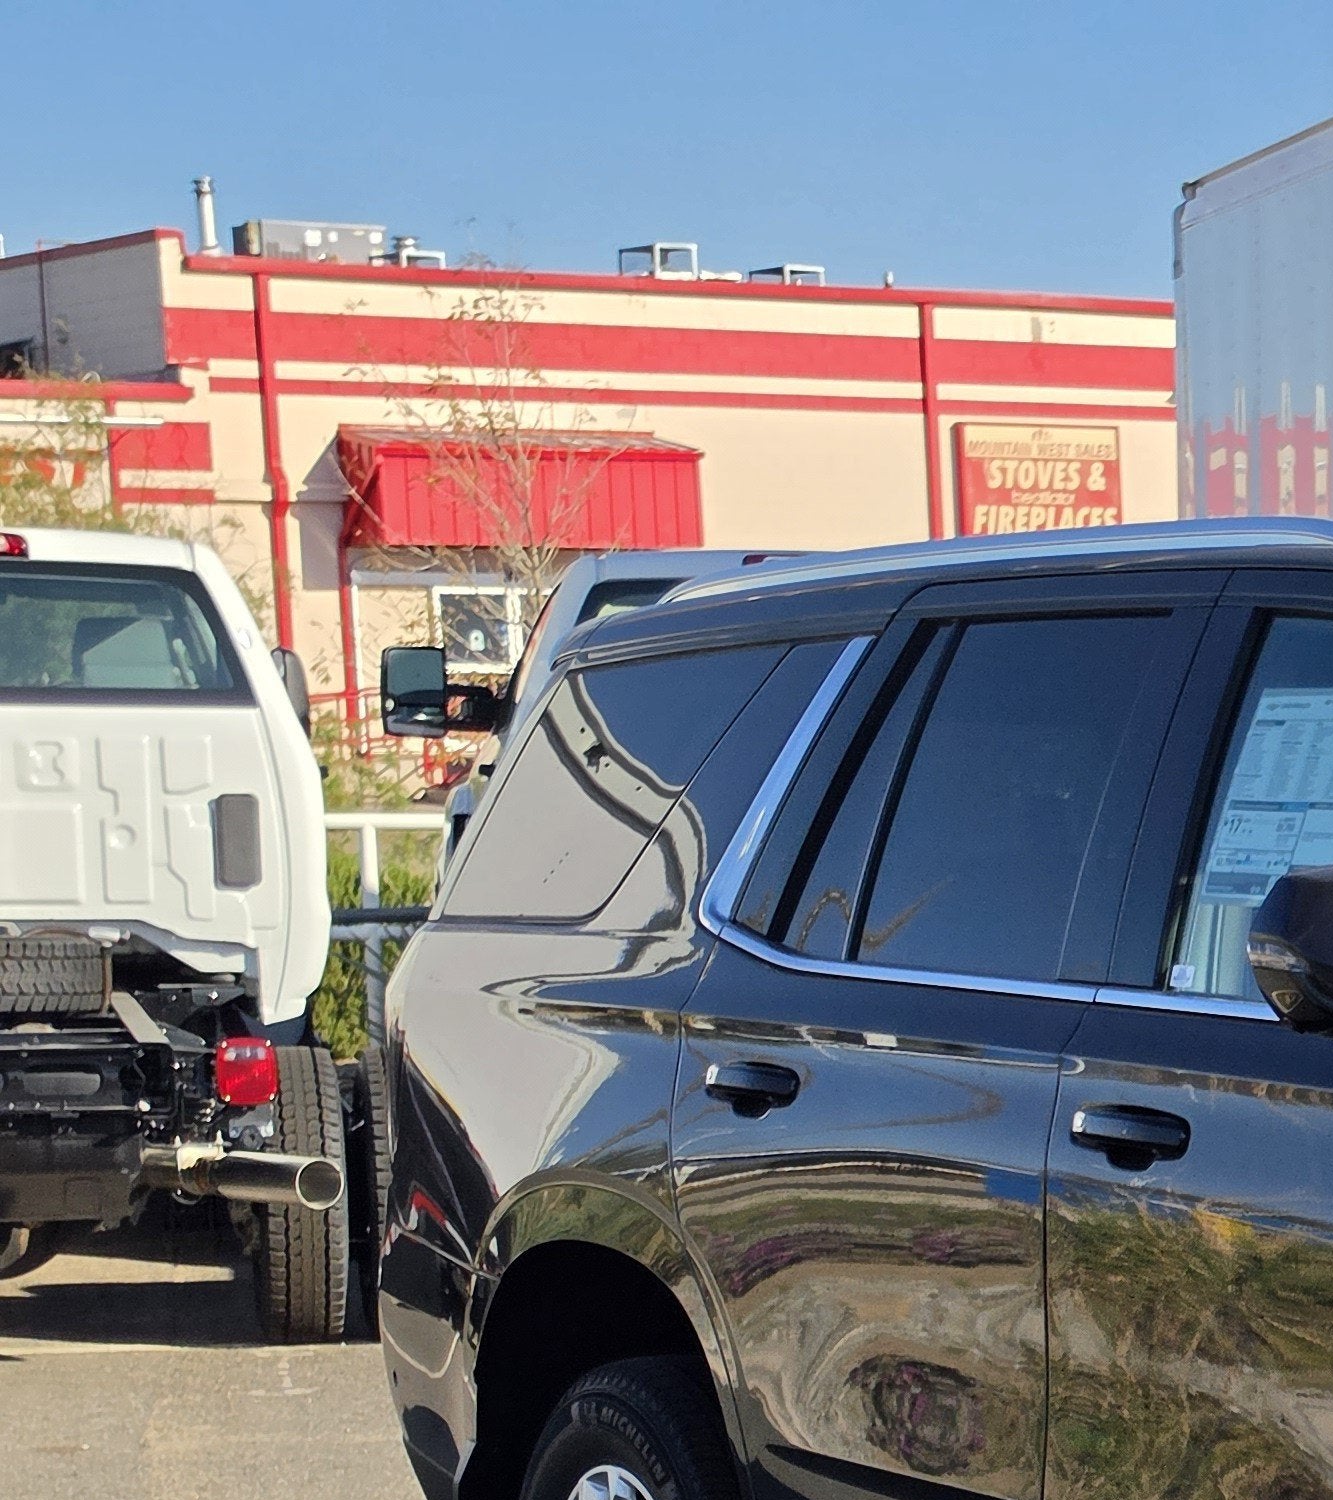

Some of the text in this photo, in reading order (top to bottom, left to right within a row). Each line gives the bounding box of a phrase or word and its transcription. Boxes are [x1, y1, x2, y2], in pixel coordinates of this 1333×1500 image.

[1036, 442, 1072, 457] WEST
[1075, 443, 1113, 458] SALES
[987, 459, 1107, 491] STOVES &
[972, 504, 1118, 535] FIREPLACES
[600, 1406, 667, 1482] MICHELIN
